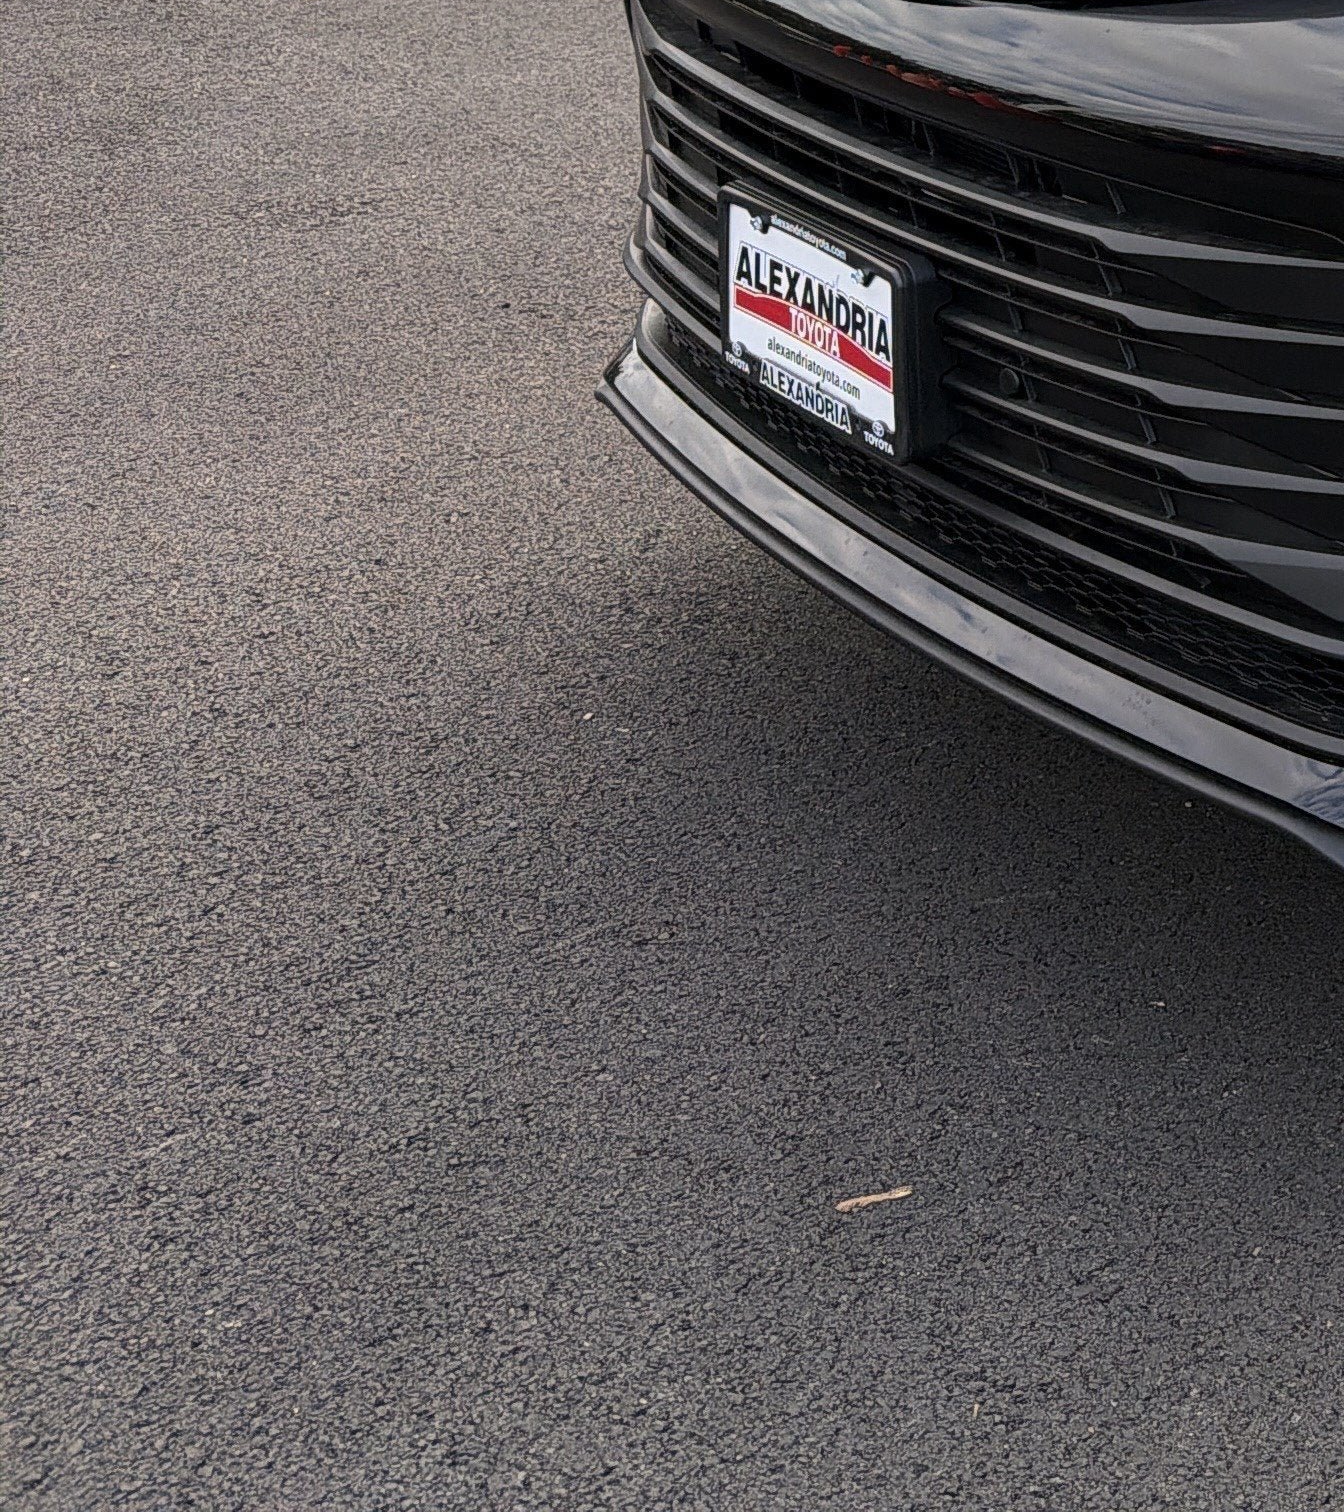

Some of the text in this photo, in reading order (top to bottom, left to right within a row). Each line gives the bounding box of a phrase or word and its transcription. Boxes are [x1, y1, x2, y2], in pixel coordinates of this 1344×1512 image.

[736, 245, 892, 362] ALEXANDRIA
[788, 306, 842, 359] TOYOTA
[761, 362, 851, 433] ALEXANDRIA
[767, 335, 861, 401] alexandriatoyota.com
[863, 430, 895, 456] TOYOTA
